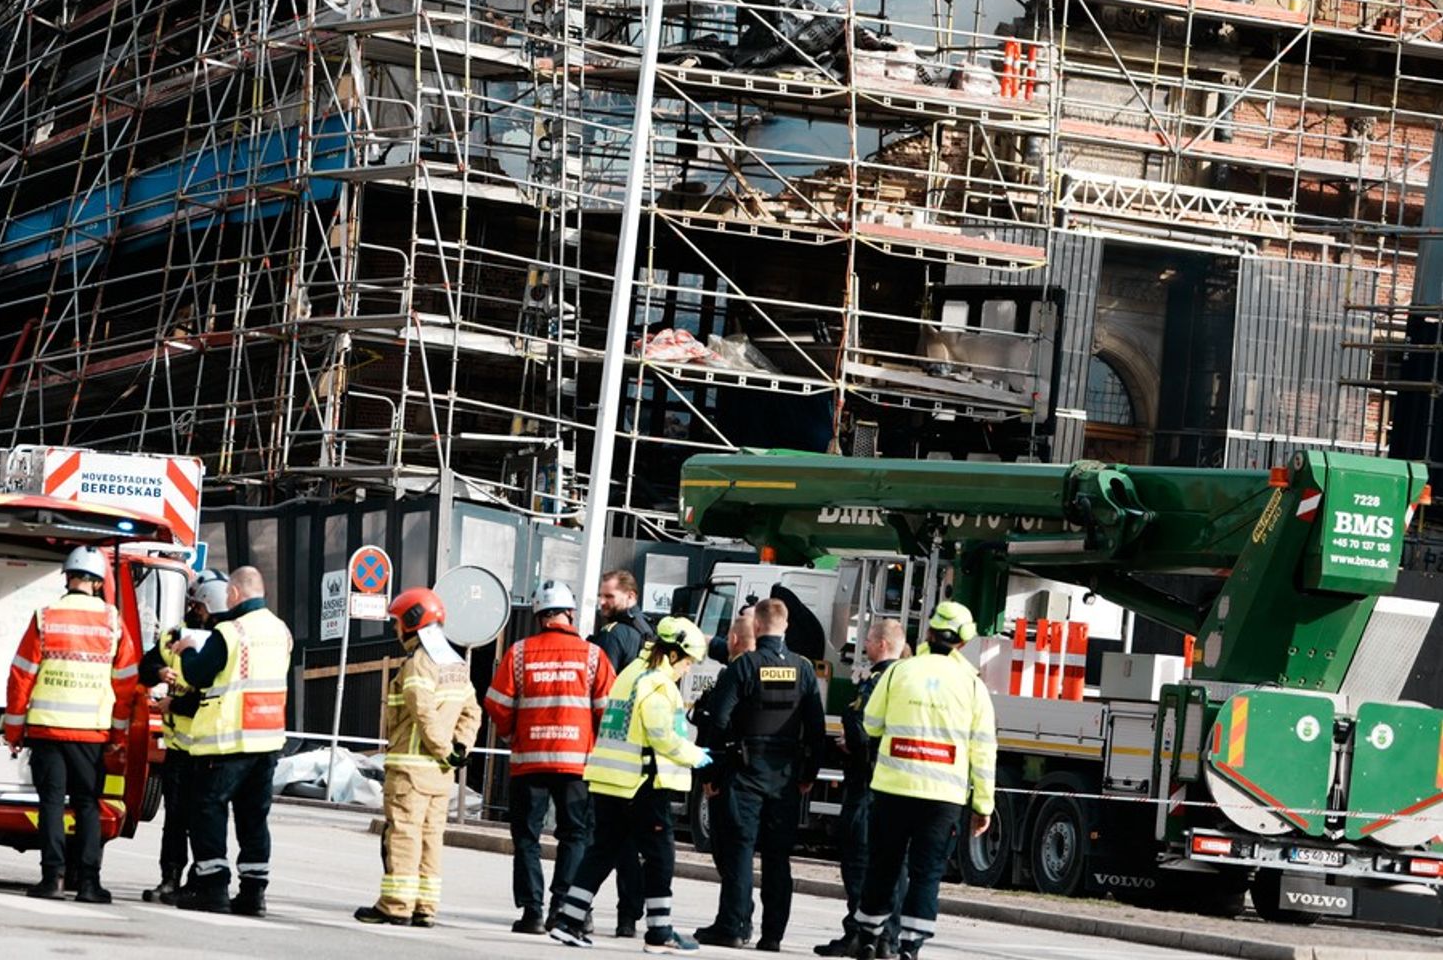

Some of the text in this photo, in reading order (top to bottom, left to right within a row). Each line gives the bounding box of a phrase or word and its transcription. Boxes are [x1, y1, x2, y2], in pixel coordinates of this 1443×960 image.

[81, 472, 163, 486] HOVEDSTADENS
[81, 482, 162, 498] BEREDSKAB
[1353, 493, 1381, 508] 7228
[1333, 510, 1394, 540] BMS
[1349, 539, 1360, 549] 70
[1330, 553, 1389, 569] www.bms.dk
[532, 671, 578, 683] BRAND
[761, 668, 797, 680] POLITI
[1094, 872, 1156, 889] VOLVO
[1286, 891, 1349, 909] VOLVO
